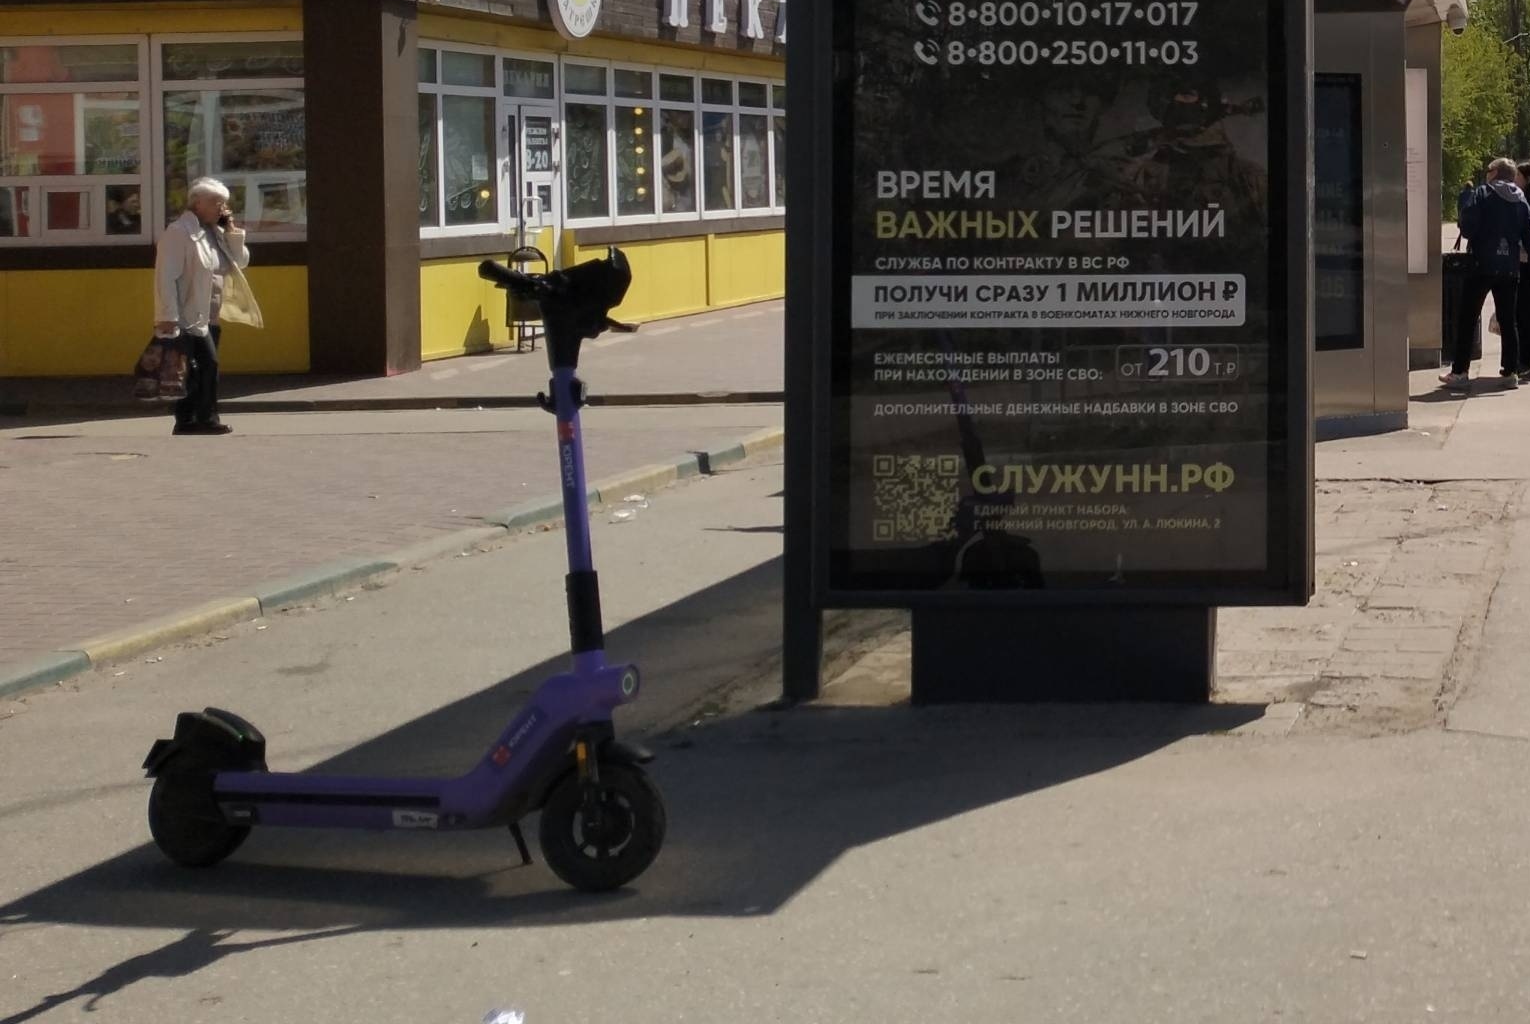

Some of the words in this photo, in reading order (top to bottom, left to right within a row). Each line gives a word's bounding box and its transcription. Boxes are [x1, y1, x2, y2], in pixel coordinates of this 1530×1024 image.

[878, 171, 995, 198] ВРЕМЯ
[877, 211, 1038, 238] ВАЖНЫХ
[1052, 203, 1224, 238] РЕШЕНИЙ
[876, 257, 942, 269] СЛУЖБА
[947, 257, 969, 269] ПО
[974, 257, 1063, 269] КОНТРАКТУ
[1069, 257, 1077, 268] В
[1082, 257, 1102, 268] ВС
[1108, 257, 1129, 270] РФ
[875, 286, 967, 302] ПОЛУЧИ
[976, 285, 1048, 302] СРАЗУ
[1057, 283, 1066, 302] 1
[1077, 282, 1215, 301] МИЛЛИОН
[898, 311, 967, 319] ЗАКЛЮЧЕНИИ
[970, 311, 1029, 319] КОНТРАКТА
[1041, 310, 1116, 319] ВОЕНКОМАТАХ
[1119, 310, 1169, 318] НИЖНЕГО
[1172, 310, 1235, 319] НОВГОРОДА
[875, 353, 983, 364] ЕЖЕМЕСЯЧНЫЕ
[988, 352, 1059, 365] ВЫПЛАТЫ
[1121, 363, 1142, 376] ОТ
[1149, 348, 1209, 375] 210
[875, 368, 902, 380] ПРИ
[905, 368, 1009, 382] НАХОЖДЕНИИ
[1014, 369, 1022, 380] В
[1027, 369, 1066, 380] ЗОНЕ
[1071, 369, 1102, 380] СВО:
[874, 404, 1002, 416] ДОПОЛНИТЕЛЬНЫЕ
[1006, 403, 1080, 416] ДЕНЕЖНЫЕ
[1084, 403, 1155, 415] НАДБАВКИ
[1160, 402, 1167, 413] В
[1172, 402, 1205, 413] ЗОНЕ
[1209, 402, 1238, 412] СВО
[973, 462, 1234, 494] СЛУЖУНН.РФ
[975, 503, 1029, 516] ЕДИНЫЙ
[1032, 505, 1073, 516] ПУНКТ
[1076, 505, 1127, 516] НАБОРА
[987, 517, 1043, 530] НИЖНИЙ
[1214, 518, 1220, 528] 2
